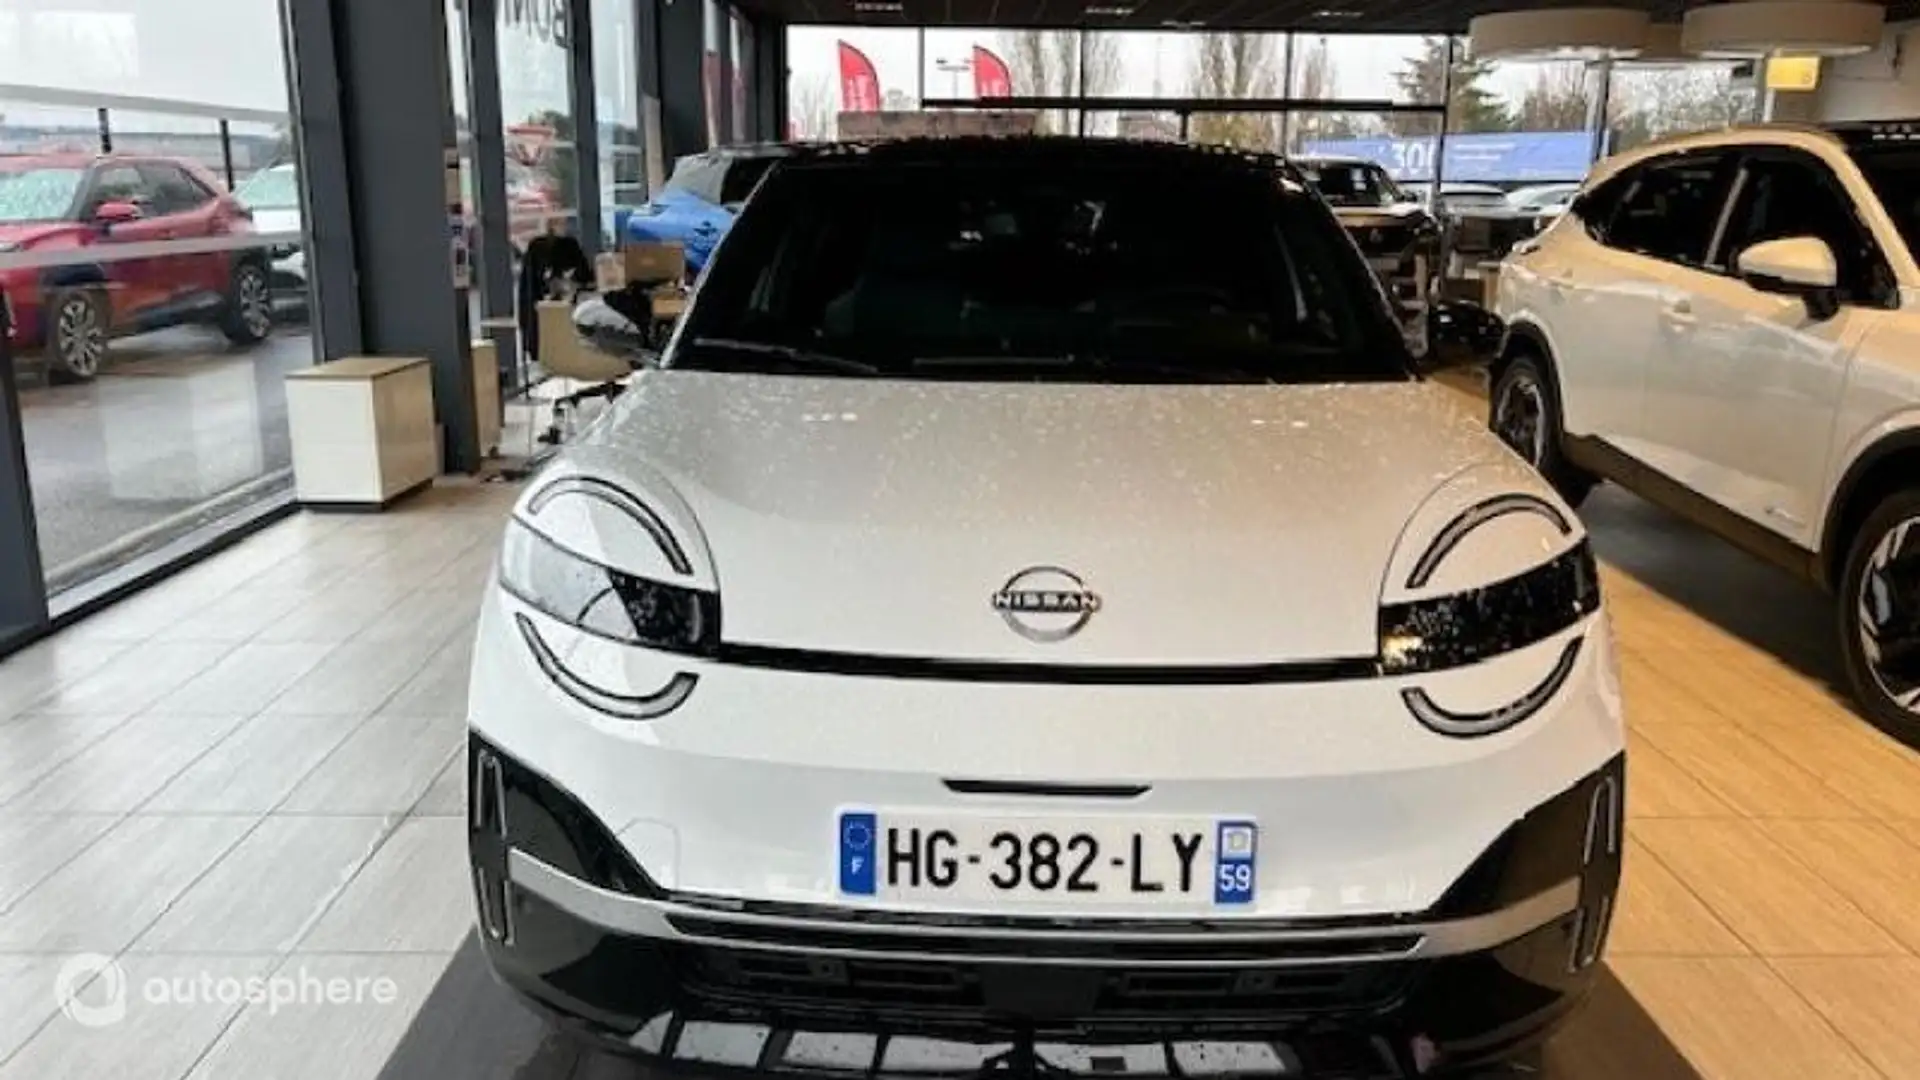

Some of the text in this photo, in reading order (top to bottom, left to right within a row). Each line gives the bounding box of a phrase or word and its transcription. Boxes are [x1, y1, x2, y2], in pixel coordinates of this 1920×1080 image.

[992, 590, 1101, 612] NISSAN
[851, 856, 865, 875] F
[887, 827, 1203, 893] HG-382-LY
[1218, 863, 1251, 892] 59
